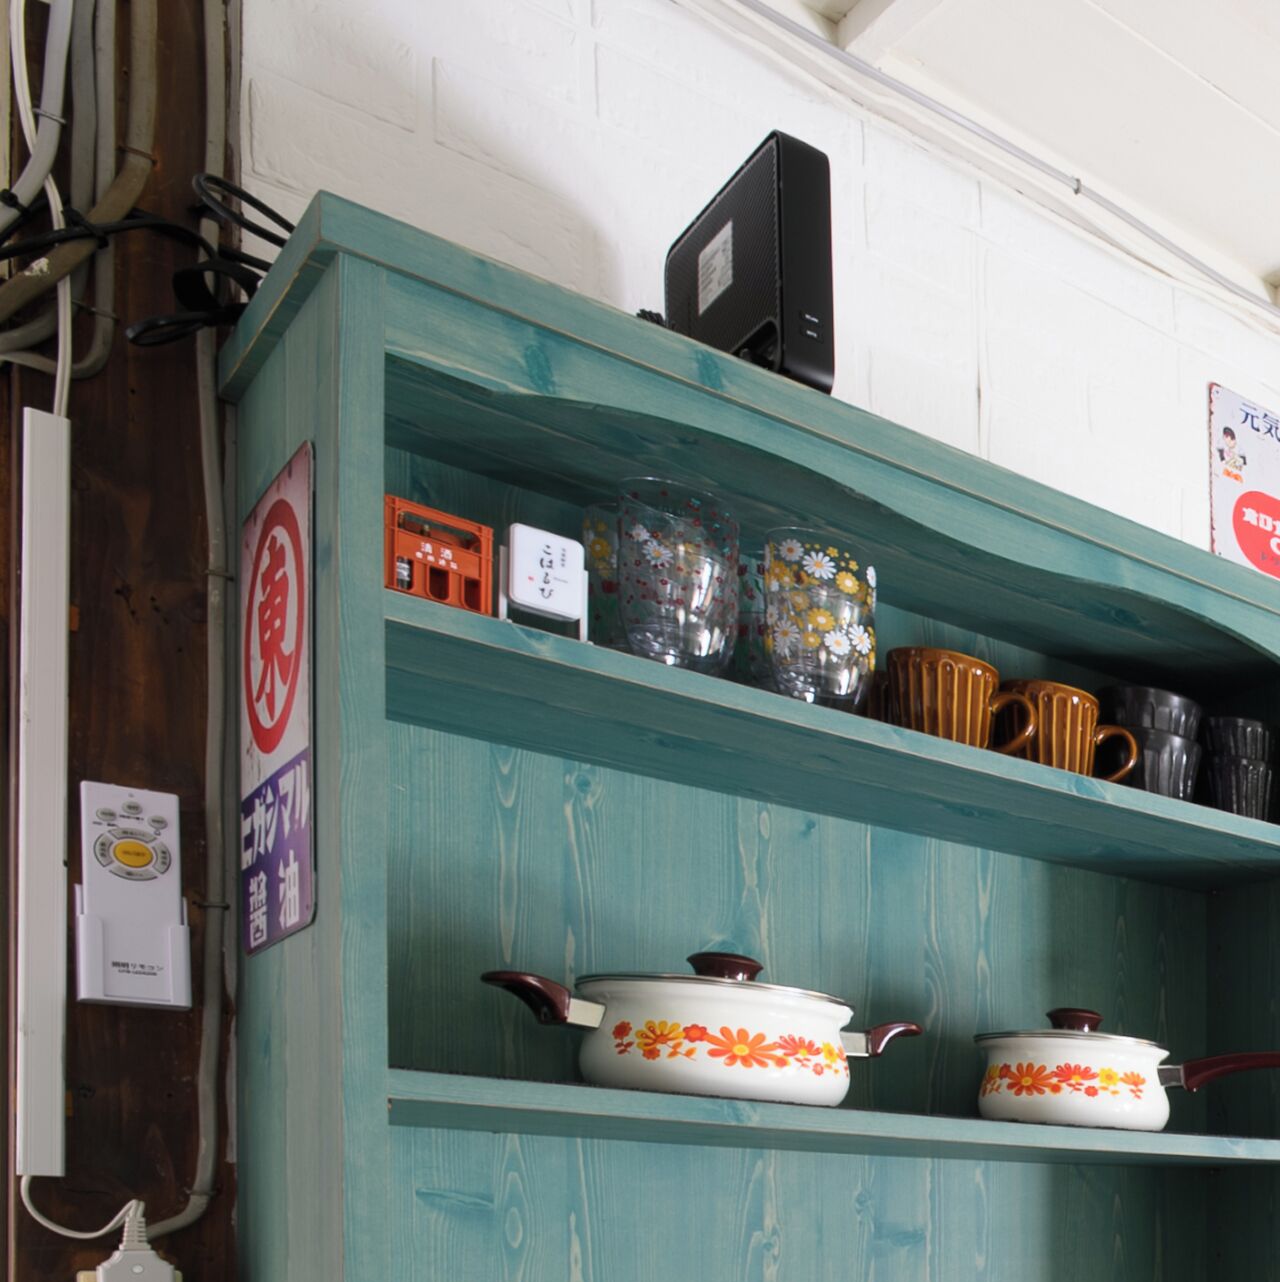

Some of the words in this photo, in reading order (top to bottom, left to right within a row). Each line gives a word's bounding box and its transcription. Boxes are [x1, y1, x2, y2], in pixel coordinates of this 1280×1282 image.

[254, 533, 294, 723] 東
[240, 759, 310, 870] ヒガシマル
